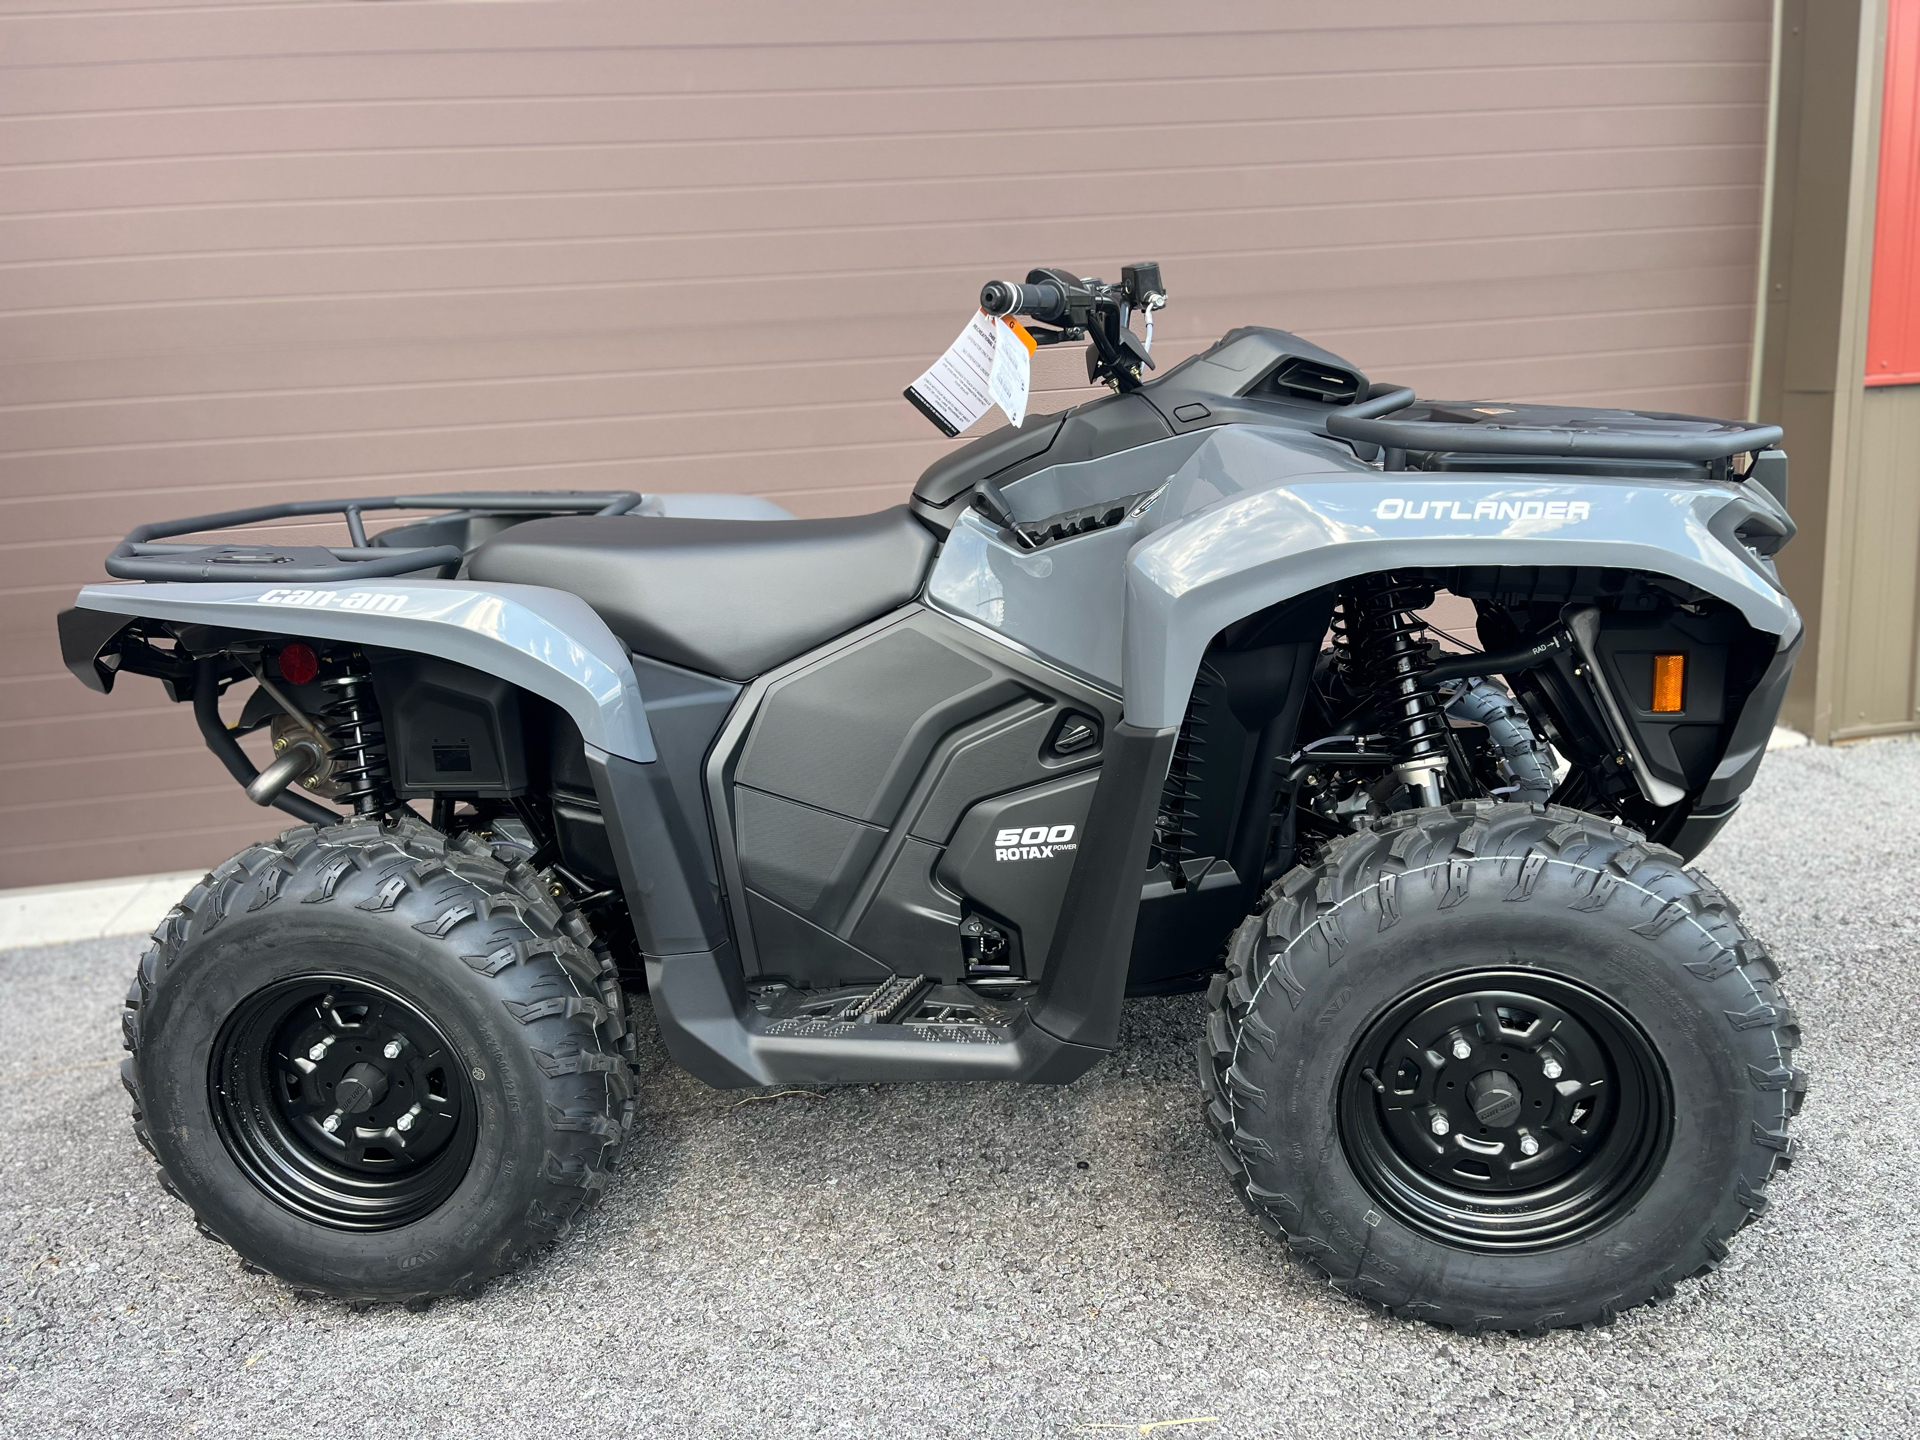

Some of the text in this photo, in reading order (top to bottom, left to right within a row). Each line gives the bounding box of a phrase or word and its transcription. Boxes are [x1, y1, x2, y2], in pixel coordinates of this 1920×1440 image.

[971, 324, 994, 346] RECREATIONAL
[1376, 498, 1591, 520] OUTLANDER
[257, 589, 409, 612] can-am
[1532, 644, 1546, 655] RAD
[994, 824, 1076, 846] 500
[996, 845, 1054, 862] ROTAX
